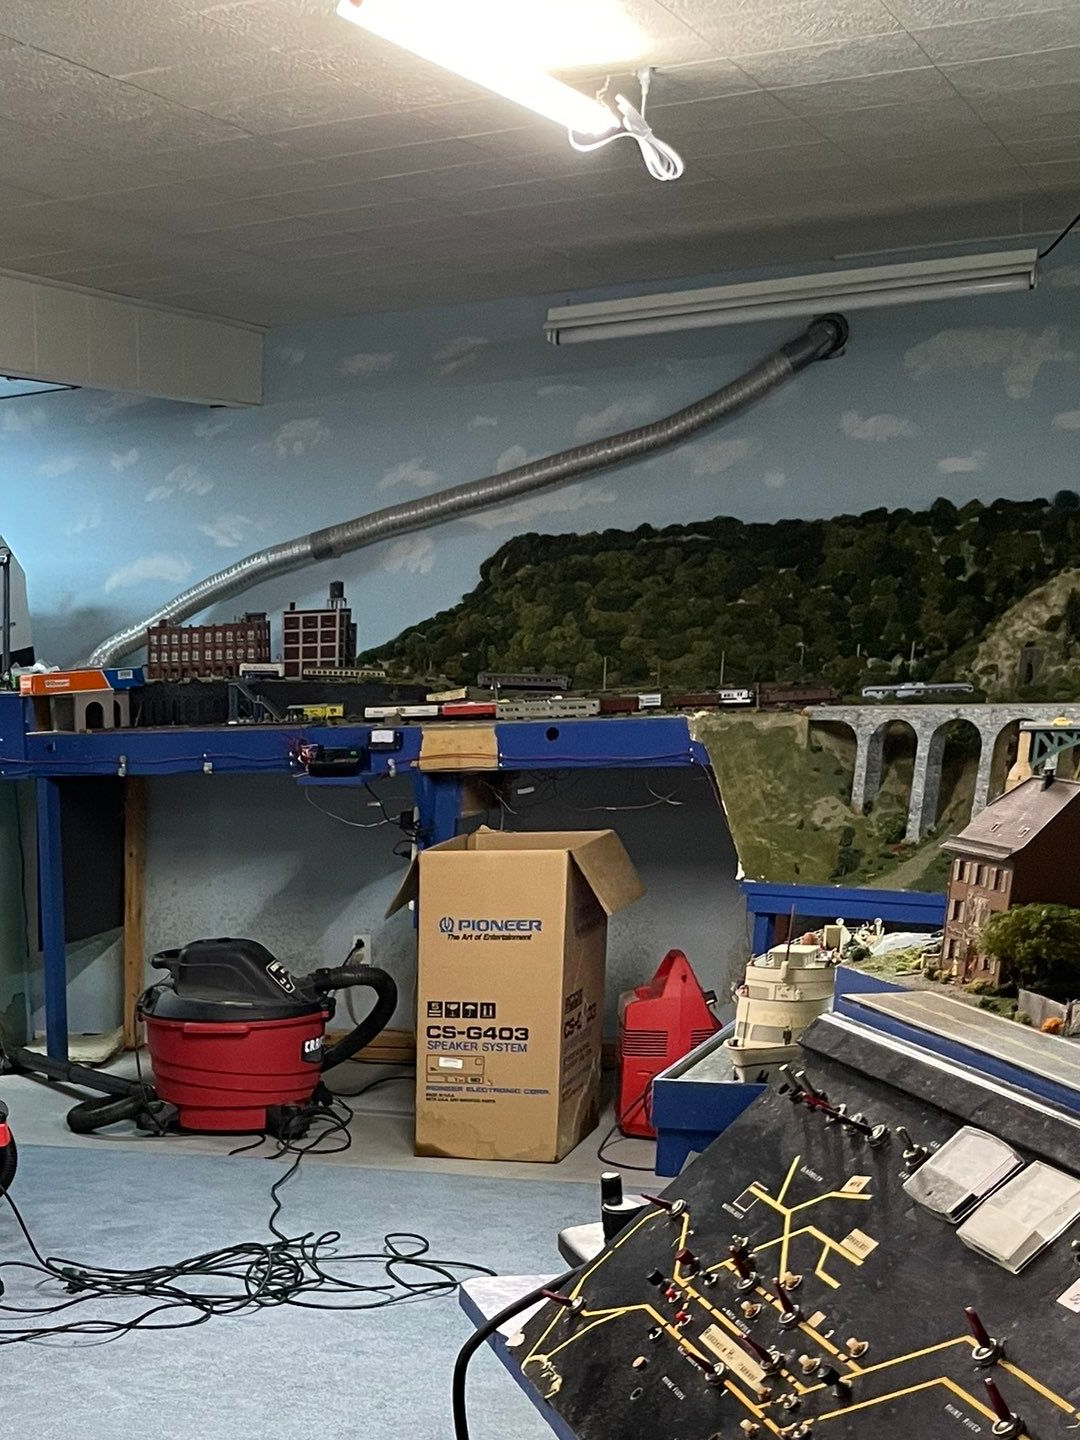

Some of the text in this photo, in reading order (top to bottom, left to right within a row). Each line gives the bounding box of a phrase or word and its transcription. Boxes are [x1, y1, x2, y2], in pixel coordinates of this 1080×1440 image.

[458, 919, 542, 932] PIONEER
[447, 933, 532, 941] The Art of Entertainment
[426, 1025, 529, 1041] CS-G403
[427, 1040, 528, 1052] SPEAKER SYSTEM
